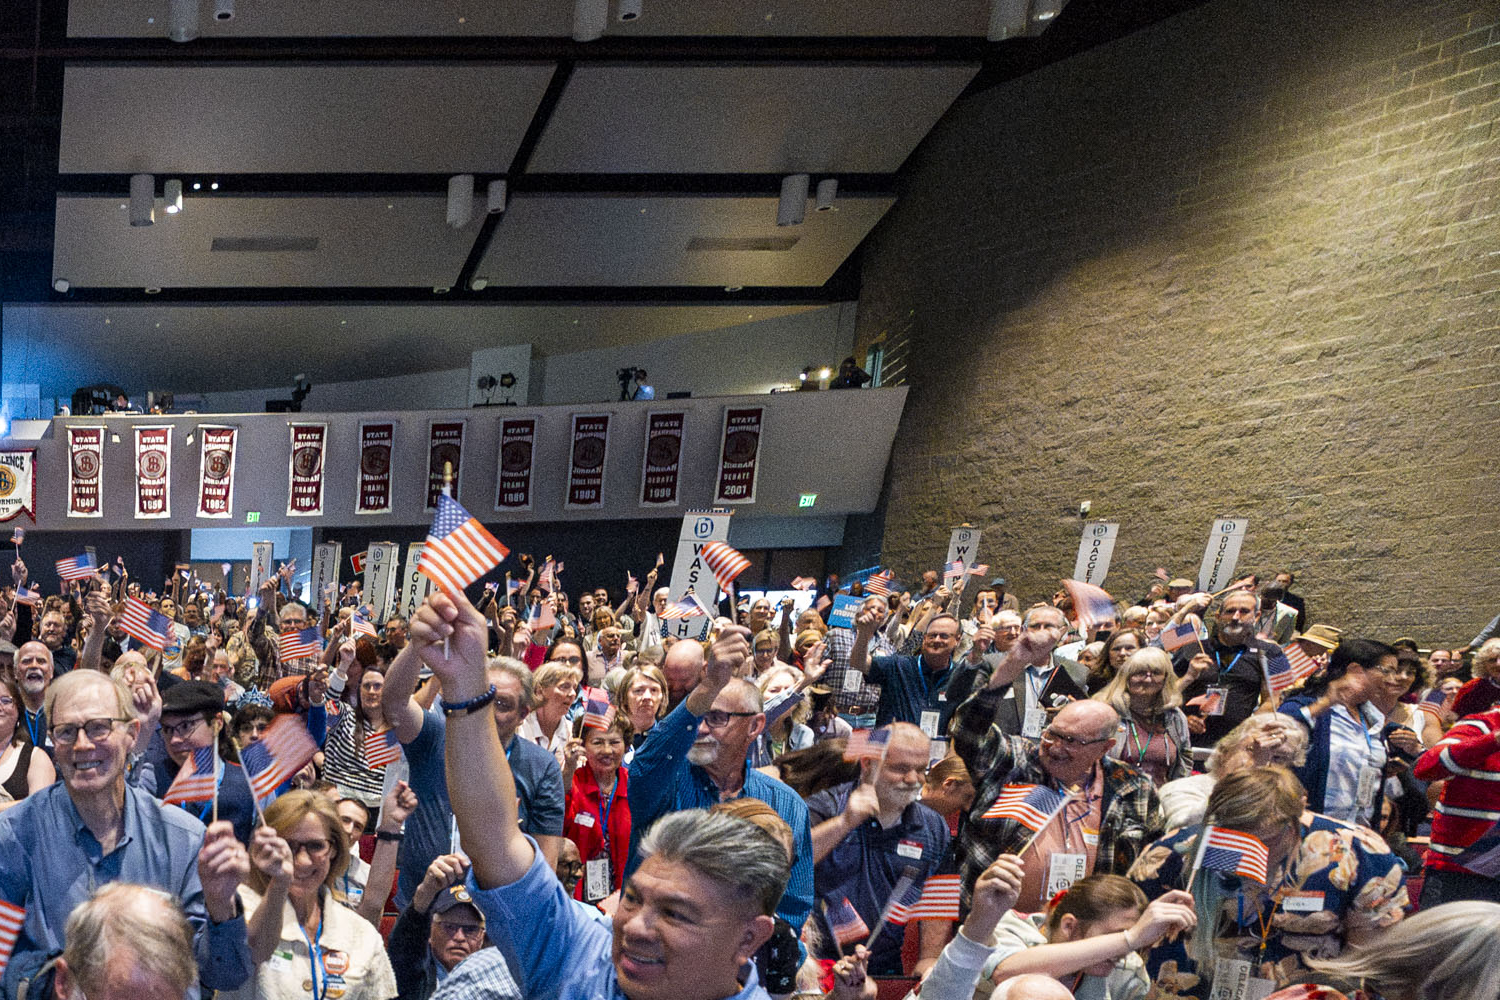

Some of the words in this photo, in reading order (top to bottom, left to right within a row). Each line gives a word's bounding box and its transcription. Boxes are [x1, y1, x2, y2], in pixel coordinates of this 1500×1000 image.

[732, 416, 757, 424] STATE
[580, 423, 604, 431] STATE
[655, 421, 678, 429] STATE
[507, 427, 529, 435] STATE
[647, 464, 677, 473] JORDAN
[724, 460, 753, 469] JORDAN
[363, 473, 388, 481] JORDAN
[502, 469, 529, 477] JORDAN
[293, 474, 320, 482] JORDAN
[724, 485, 747, 495] 2001
[206, 499, 225, 508] 1962
[799, 495, 816, 506] EXIT
[247, 512, 260, 522] EXIT
[1207, 537, 1228, 592] DUCHESNE
[678, 544, 704, 636] WASAH
